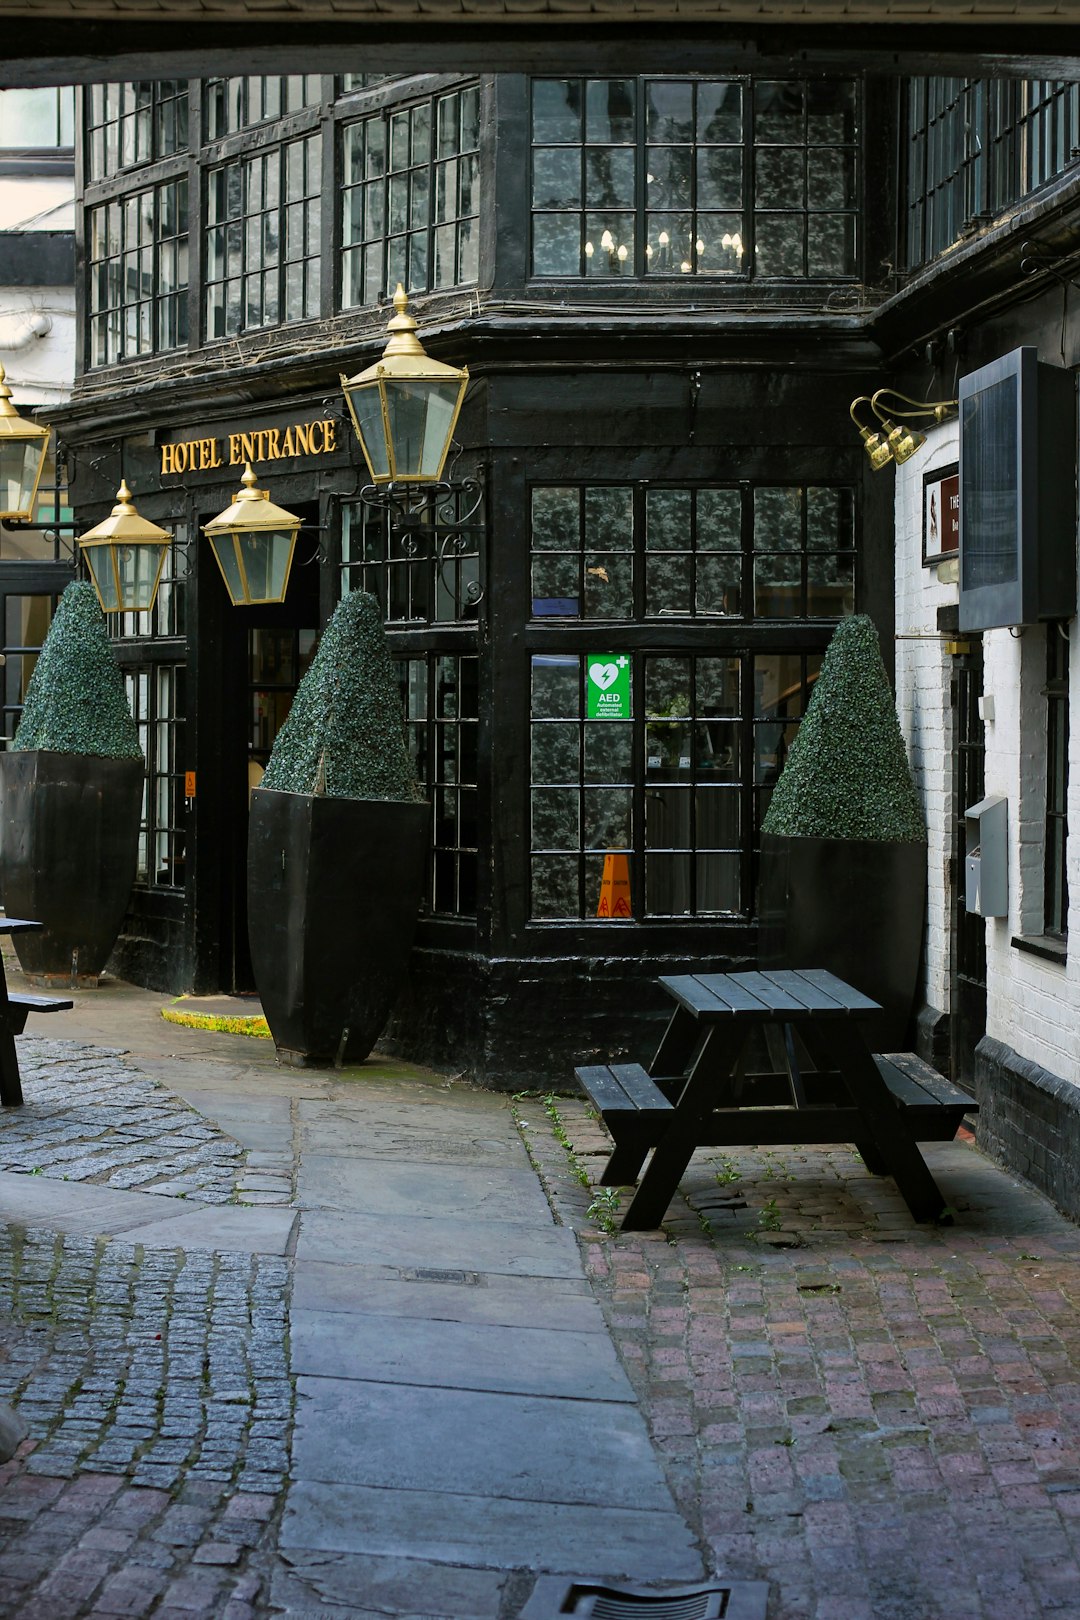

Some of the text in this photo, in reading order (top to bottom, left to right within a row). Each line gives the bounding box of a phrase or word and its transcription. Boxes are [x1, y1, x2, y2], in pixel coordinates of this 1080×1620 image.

[160, 419, 337, 475] HOTEL ENTRANCE
[949, 494, 960, 510] THE
[598, 693, 621, 703] AED
